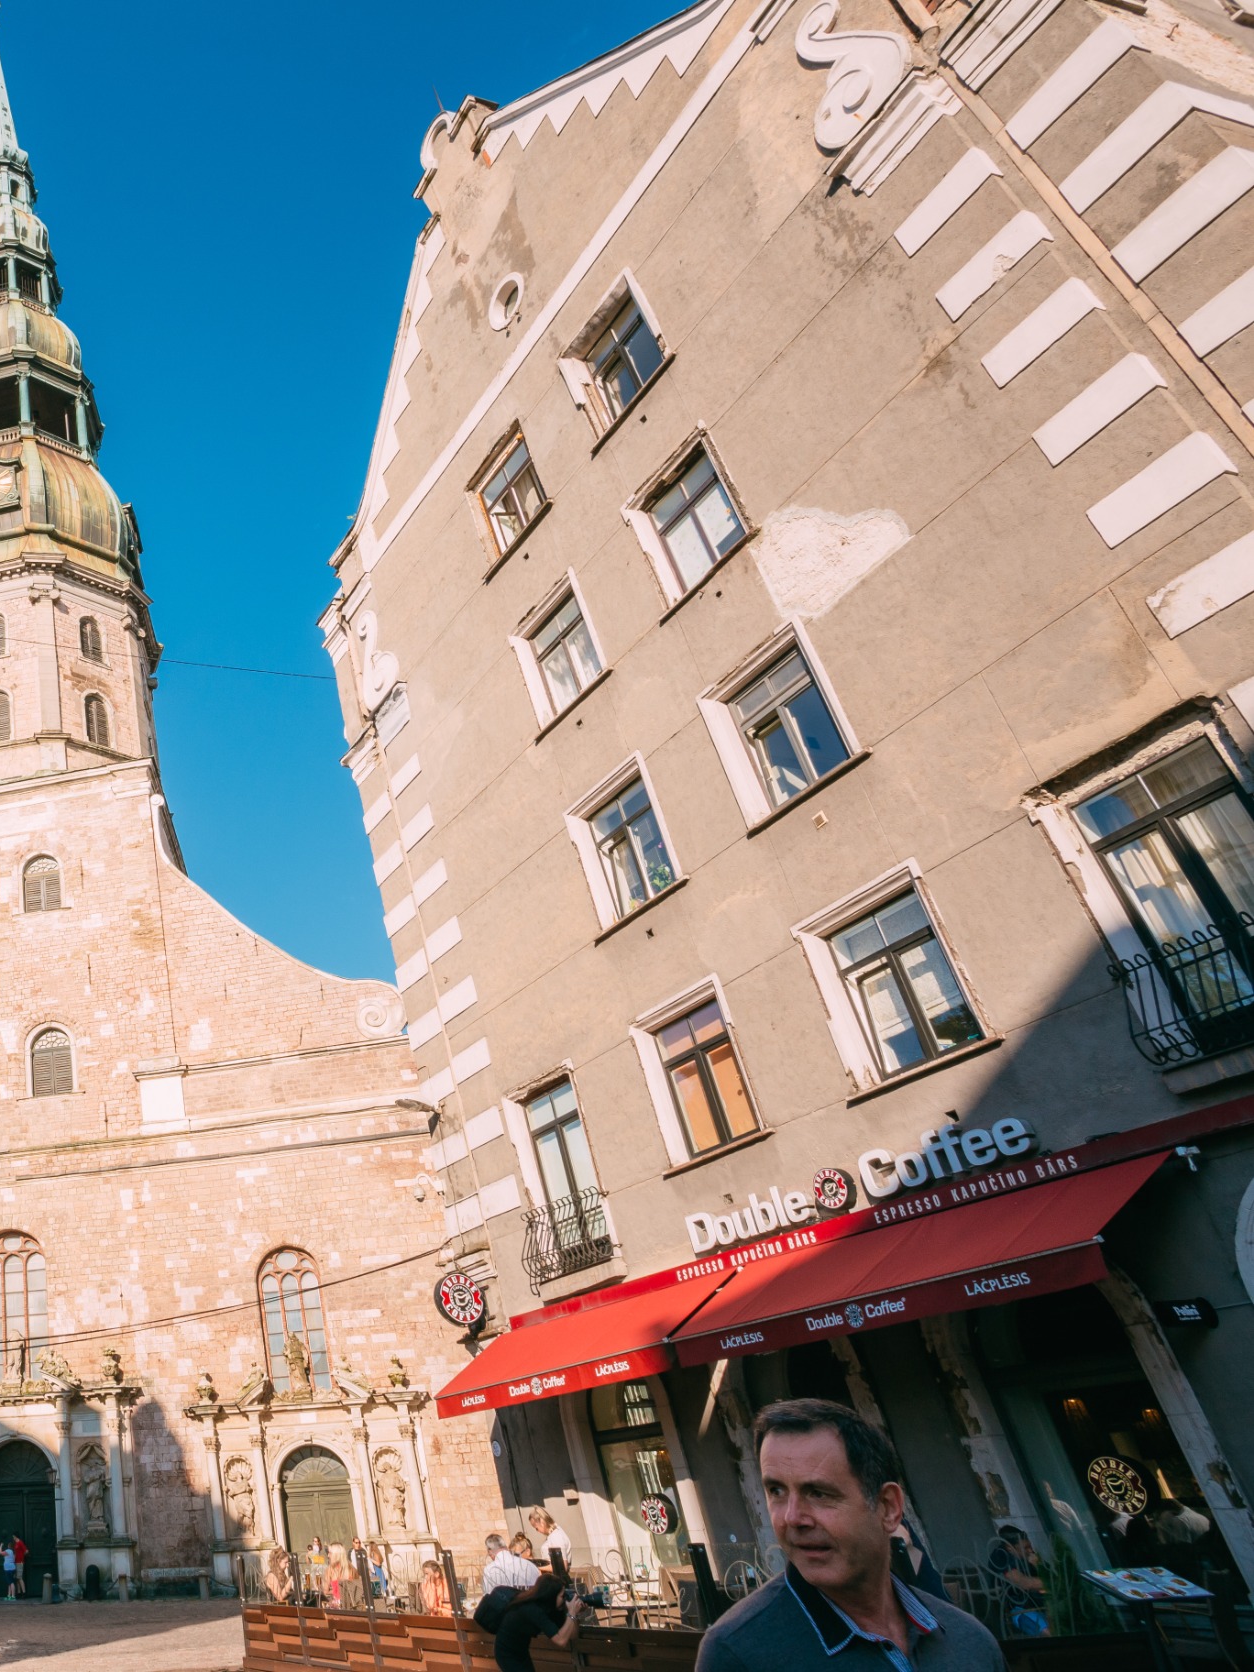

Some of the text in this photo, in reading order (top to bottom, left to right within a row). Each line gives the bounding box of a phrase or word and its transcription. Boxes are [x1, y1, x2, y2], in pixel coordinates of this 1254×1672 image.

[685, 1117, 1031, 1254] Double Coffee
[874, 1155, 1078, 1224] ESPRESSO KAPUČĪNO BĀRS
[676, 1231, 817, 1281] ESPRESSO KAPUČĪNO BĀRS
[443, 1275, 479, 1293] DOUBLE
[964, 1272, 1031, 1296] LĀČPLĒSIS
[446, 1302, 482, 1321] COFFEE
[806, 1312, 843, 1331] Double
[720, 1332, 764, 1350] LĀČPLĒSIS
[508, 1383, 531, 1397] Double
[1090, 1459, 1135, 1480] DOUBLE
[1099, 1490, 1145, 1512] COFFEE
